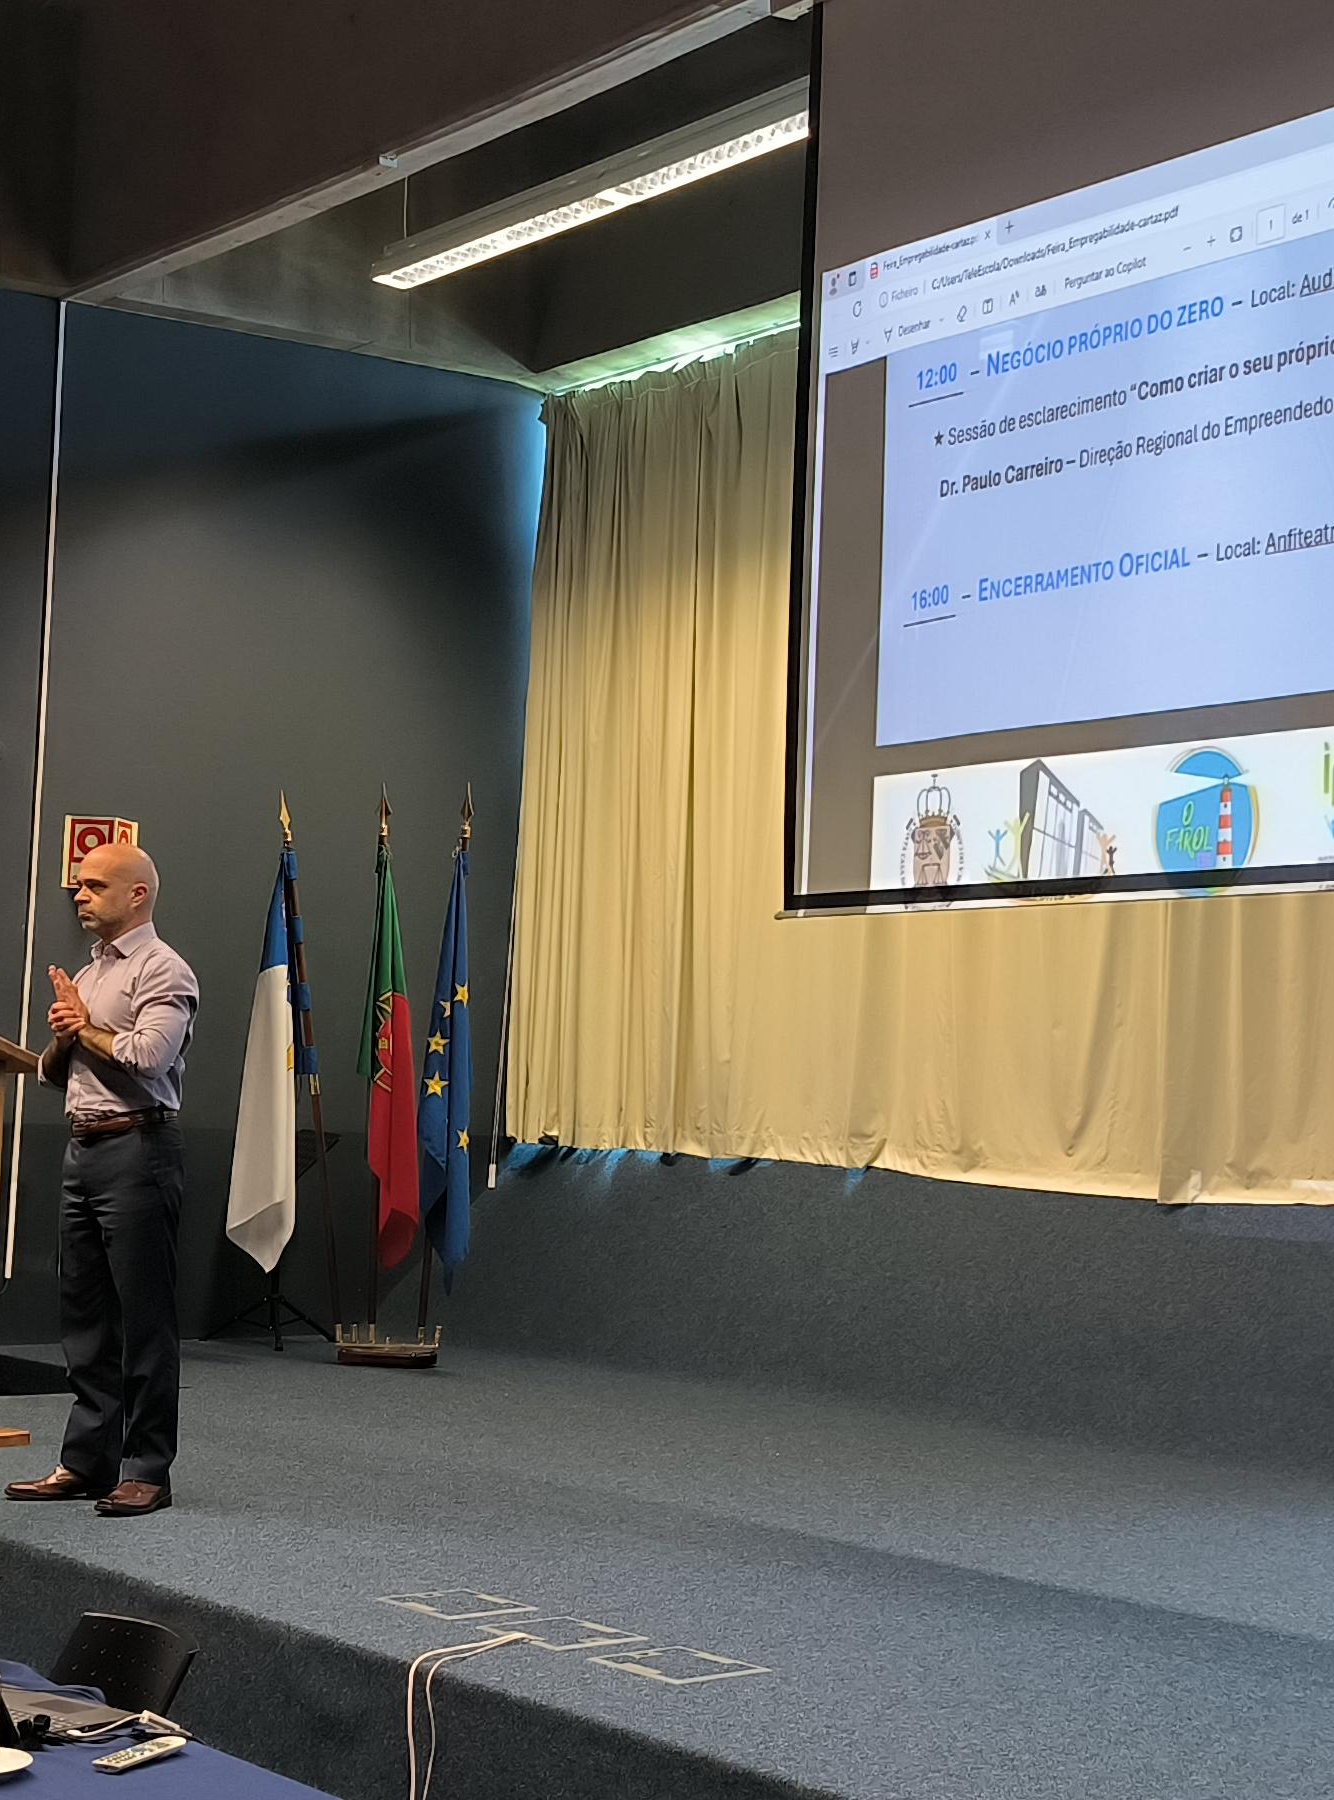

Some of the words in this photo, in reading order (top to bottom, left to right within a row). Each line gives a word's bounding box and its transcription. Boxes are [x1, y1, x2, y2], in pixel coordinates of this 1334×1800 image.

[1064, 268, 1103, 289] Perguntar
[1104, 265, 1115, 278] ao
[1116, 256, 1147, 275] Copilot
[897, 317, 931, 338] Desenhar
[916, 362, 958, 390] 12:00
[986, 339, 1064, 377] NEGÓCIO
[1067, 317, 1143, 356] PRÓPRIO
[1147, 309, 1173, 335] DO
[1176, 295, 1224, 327] ZERO
[1250, 280, 1297, 308] Local:
[947, 419, 996, 446] Sessão
[998, 415, 1016, 434] de
[1018, 389, 1127, 428] esclarecimento
[1187, 364, 1225, 389] criar
[1228, 363, 1239, 379] o
[1243, 352, 1273, 376] seu
[939, 479, 959, 498] Dr.
[961, 470, 1002, 493] Paulo
[1004, 456, 1064, 484] Carreiro
[1079, 440, 1132, 469] Direção
[1135, 424, 1198, 457] Regional
[1201, 420, 1221, 439] do
[910, 583, 949, 612] 16:00
[978, 560, 1114, 602] ENCERRAMENTO
[1118, 546, 1191, 579] OFICIAL
[1216, 537, 1261, 562] Local:
[1165, 826, 1213, 860] FAROL
